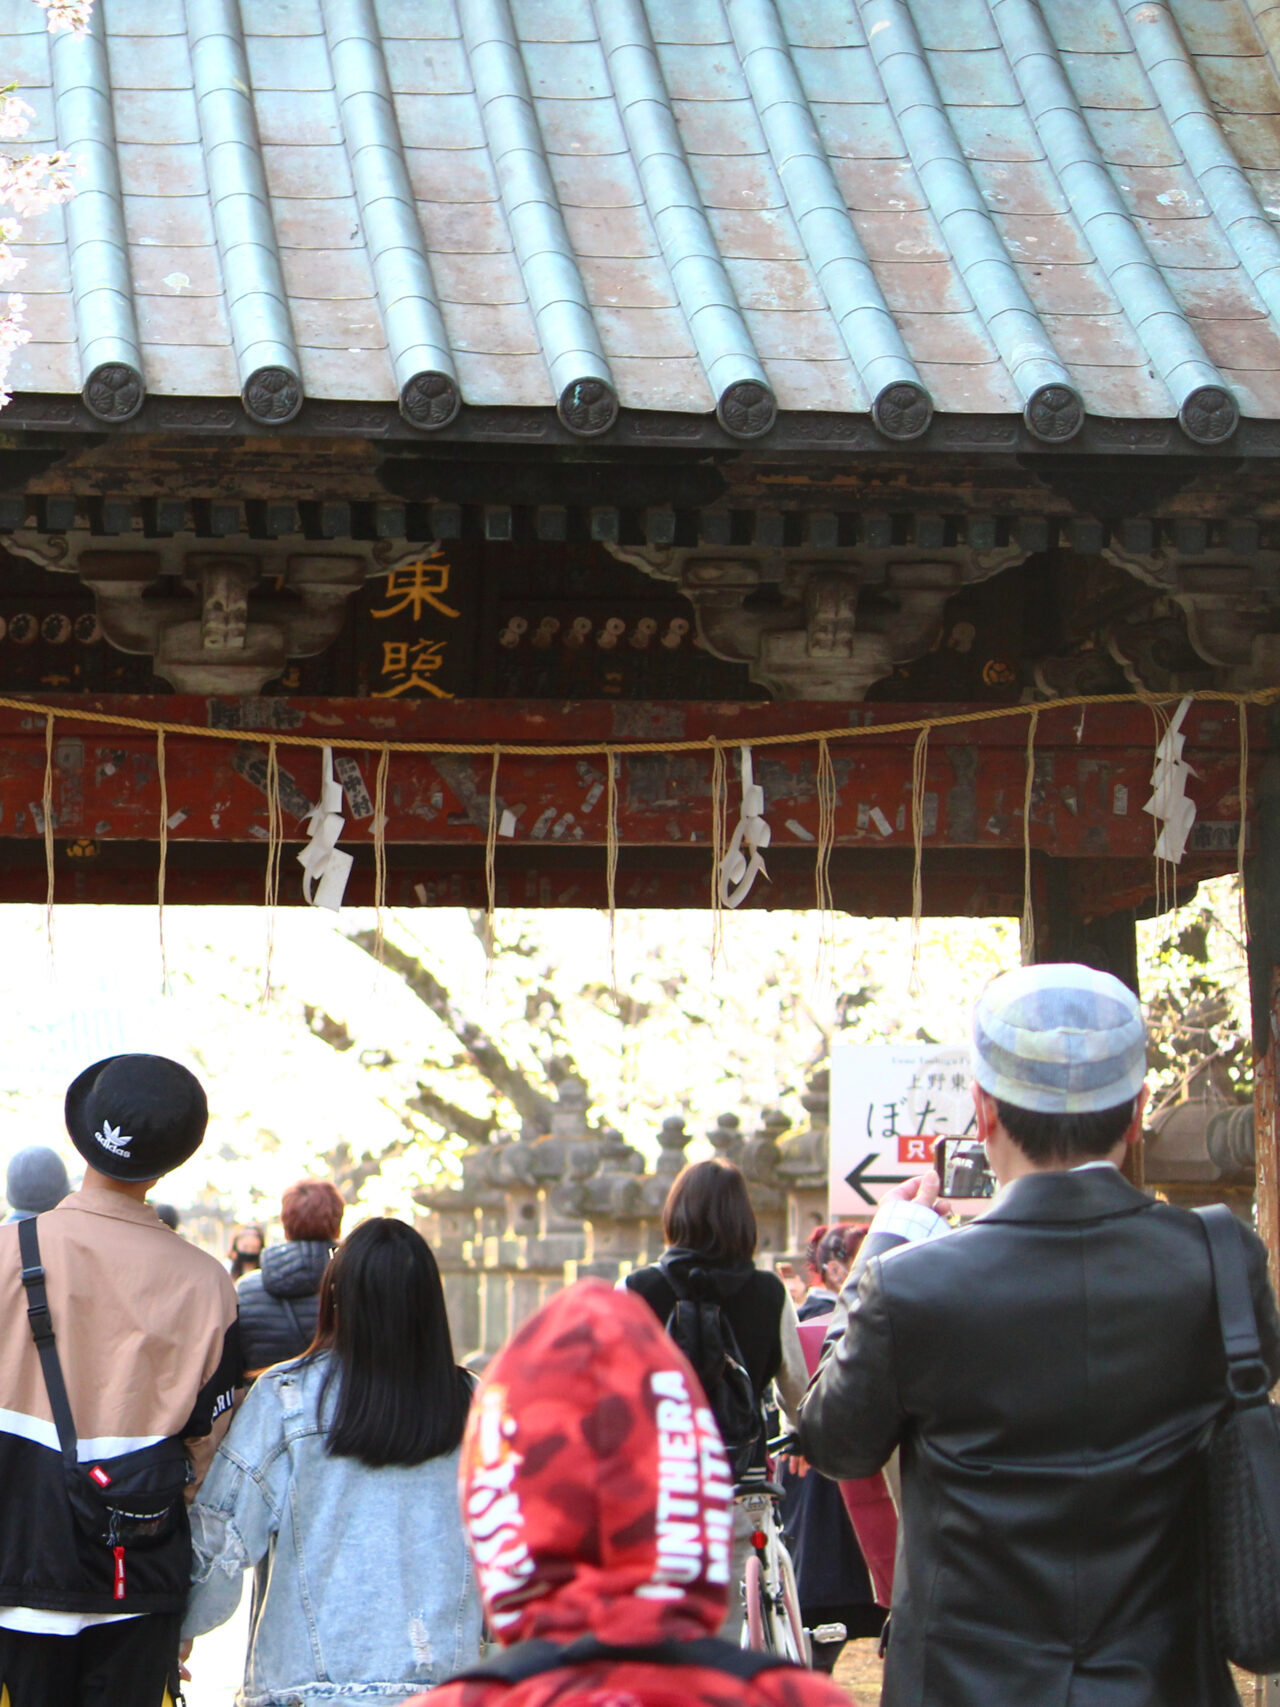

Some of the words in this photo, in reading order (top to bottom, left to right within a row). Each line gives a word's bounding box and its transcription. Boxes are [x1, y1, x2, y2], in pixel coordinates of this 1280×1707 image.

[906, 1073, 974, 1092] 上野東
[95, 1131, 131, 1158] adidas
